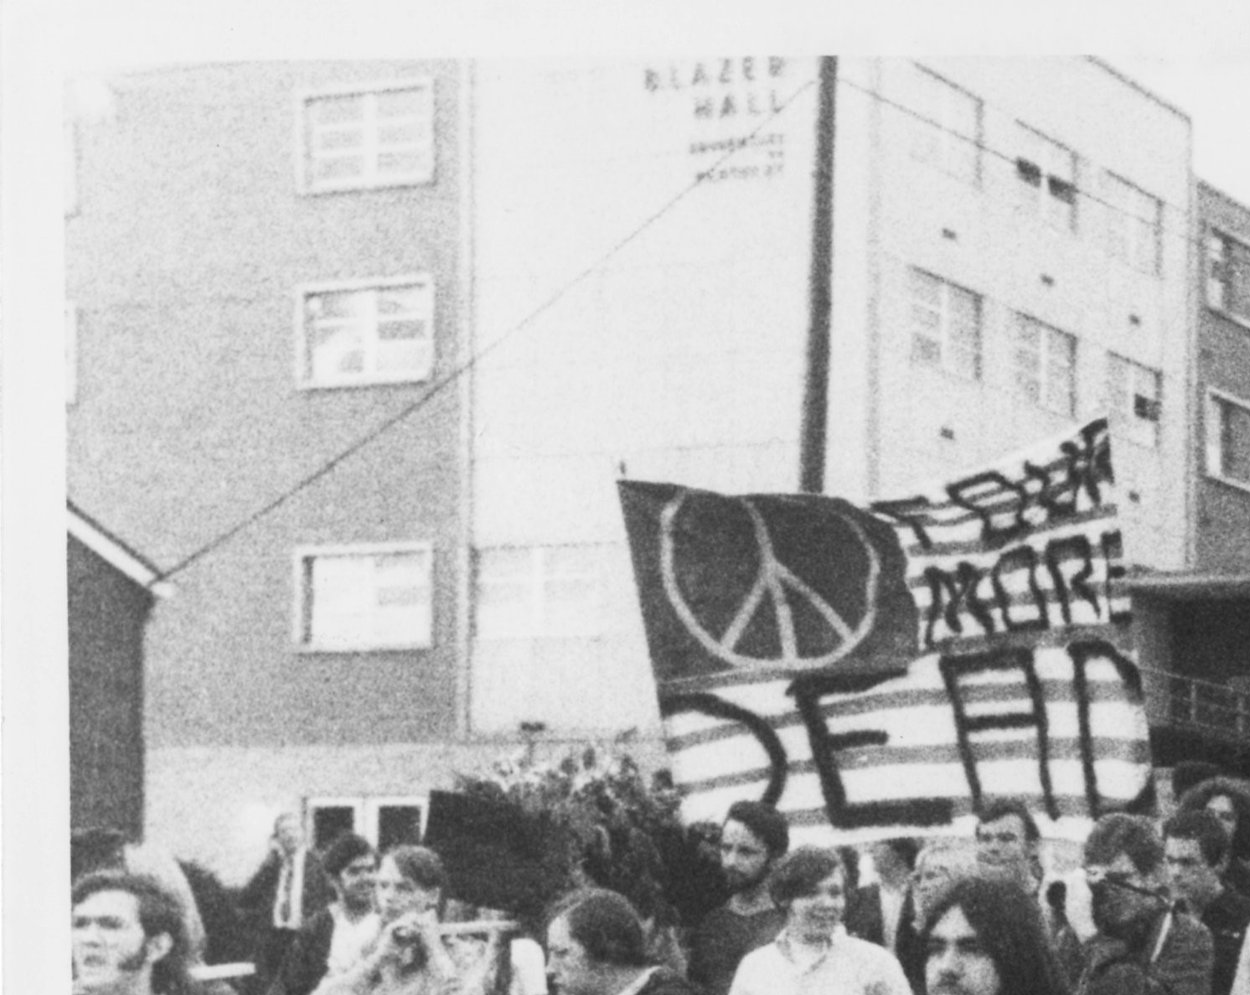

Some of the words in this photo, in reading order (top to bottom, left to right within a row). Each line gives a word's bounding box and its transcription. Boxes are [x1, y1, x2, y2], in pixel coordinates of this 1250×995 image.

[643, 56, 787, 92] BLAZER
[693, 89, 782, 120] HALL
[923, 529, 1133, 652] MORE
[661, 640, 1158, 830] DEAD
